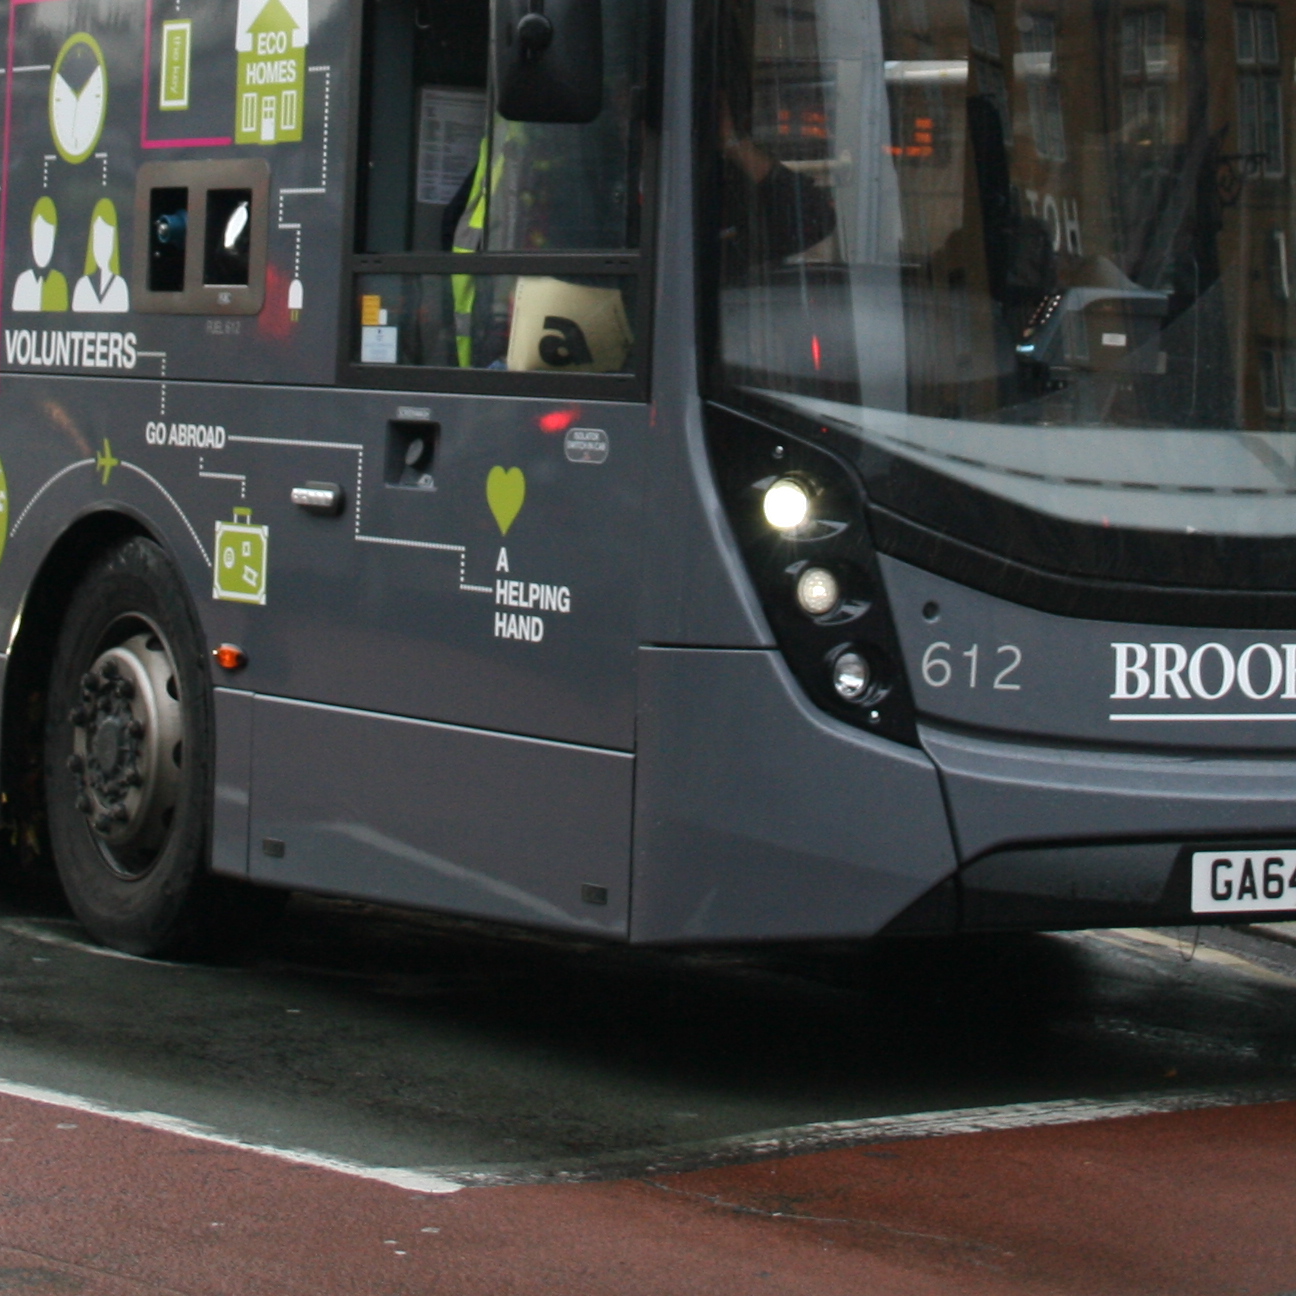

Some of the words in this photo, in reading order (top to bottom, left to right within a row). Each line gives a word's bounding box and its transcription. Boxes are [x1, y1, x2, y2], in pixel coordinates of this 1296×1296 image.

[257, 31, 288, 56] ECO
[245, 60, 297, 85] HOMES
[4, 329, 138, 370] VOLUNTEERS
[145, 421, 167, 446] GO
[168, 423, 226, 449] ABROAD
[495, 547, 510, 573] A
[495, 580, 571, 613] HELPING
[493, 612, 544, 643] HAND
[920, 641, 1023, 692] 612
